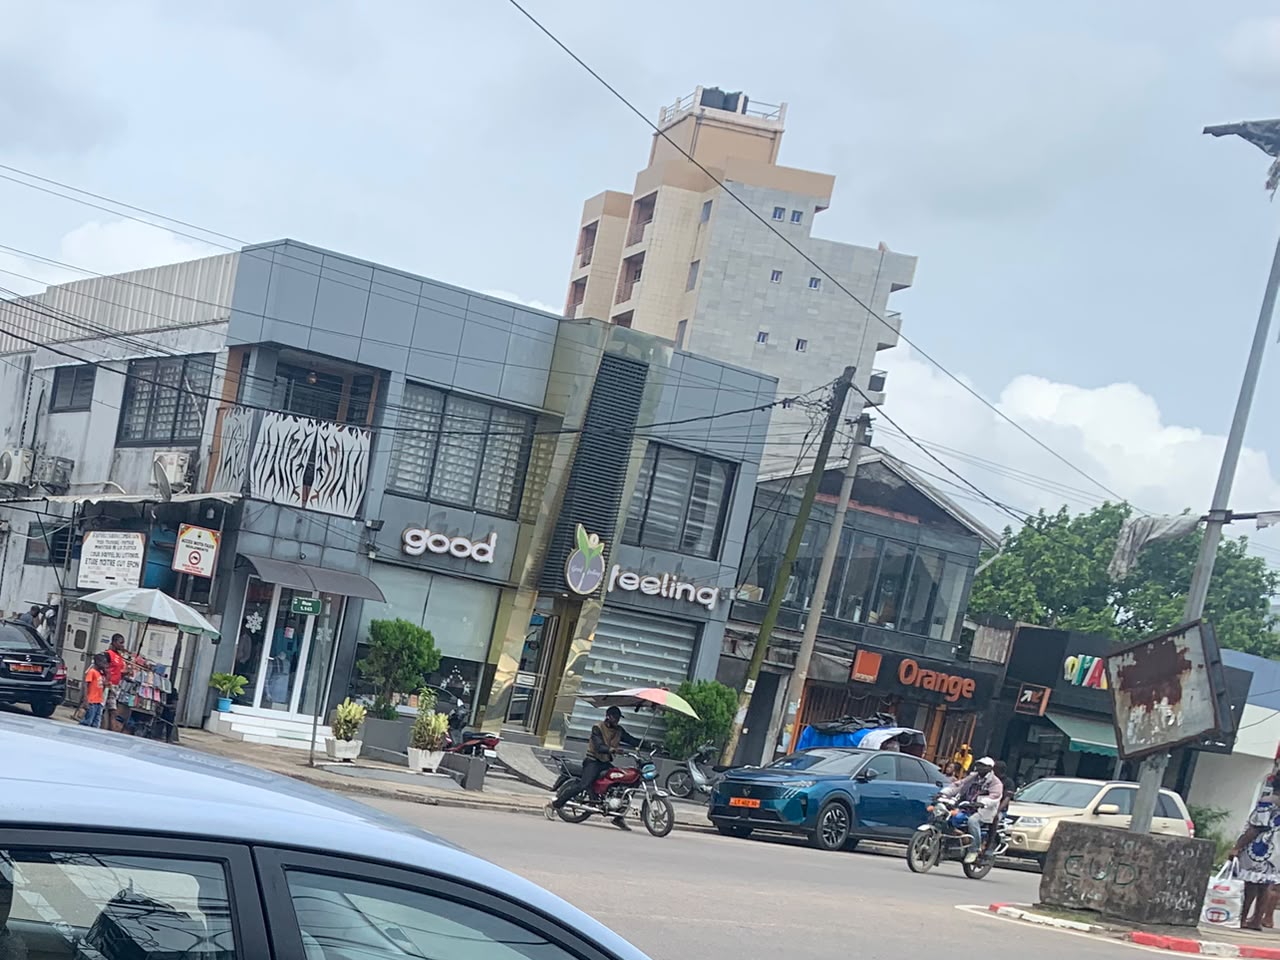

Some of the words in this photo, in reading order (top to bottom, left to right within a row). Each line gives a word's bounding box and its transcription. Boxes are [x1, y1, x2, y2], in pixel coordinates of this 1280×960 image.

[402, 528, 498, 563] good
[608, 564, 720, 611] feeling
[898, 658, 976, 702] Orange
